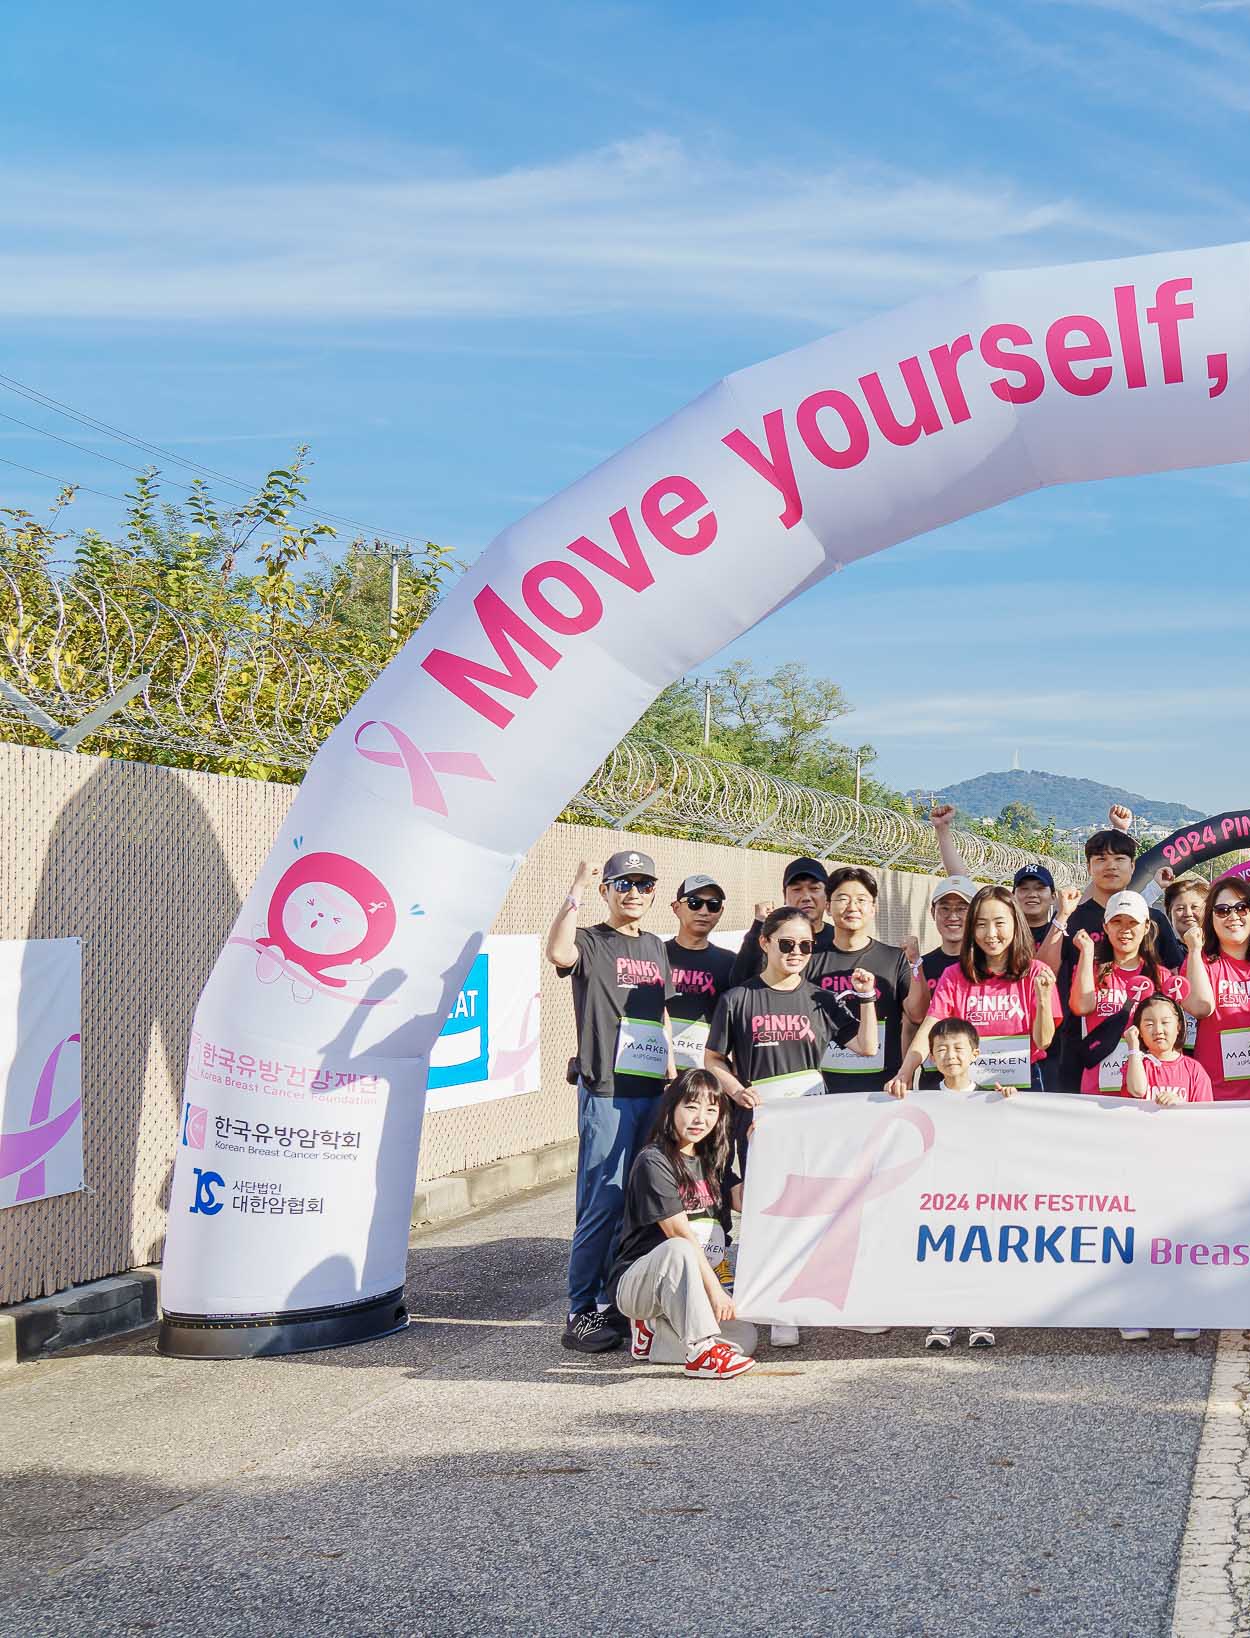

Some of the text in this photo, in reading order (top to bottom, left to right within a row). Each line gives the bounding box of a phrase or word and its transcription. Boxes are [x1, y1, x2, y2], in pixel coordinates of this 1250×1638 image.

[420, 475, 719, 729] Move
[721, 278, 1229, 530] yourself,
[1162, 825, 1217, 866] 2024
[672, 968, 704, 985] iNK
[821, 976, 853, 991] PiN
[447, 989, 478, 1019] AT
[1096, 988, 1128, 1003] PiN
[966, 1010, 1009, 1021] FESTIVAL
[752, 1030, 800, 1041] FESTIVAL
[225, 1076, 258, 1093] Breast
[263, 1085, 305, 1100] Cancer
[215, 1115, 361, 1150] 한국유방암학회
[215, 1139, 358, 1162] Korean Breast Cancer Society
[233, 1180, 282, 1196] 사단법인
[232, 1195, 325, 1215] 대한암협회
[919, 1192, 1137, 1213] 2024 PINK FESTIVAL
[916, 1224, 1136, 1265] MARKEN
